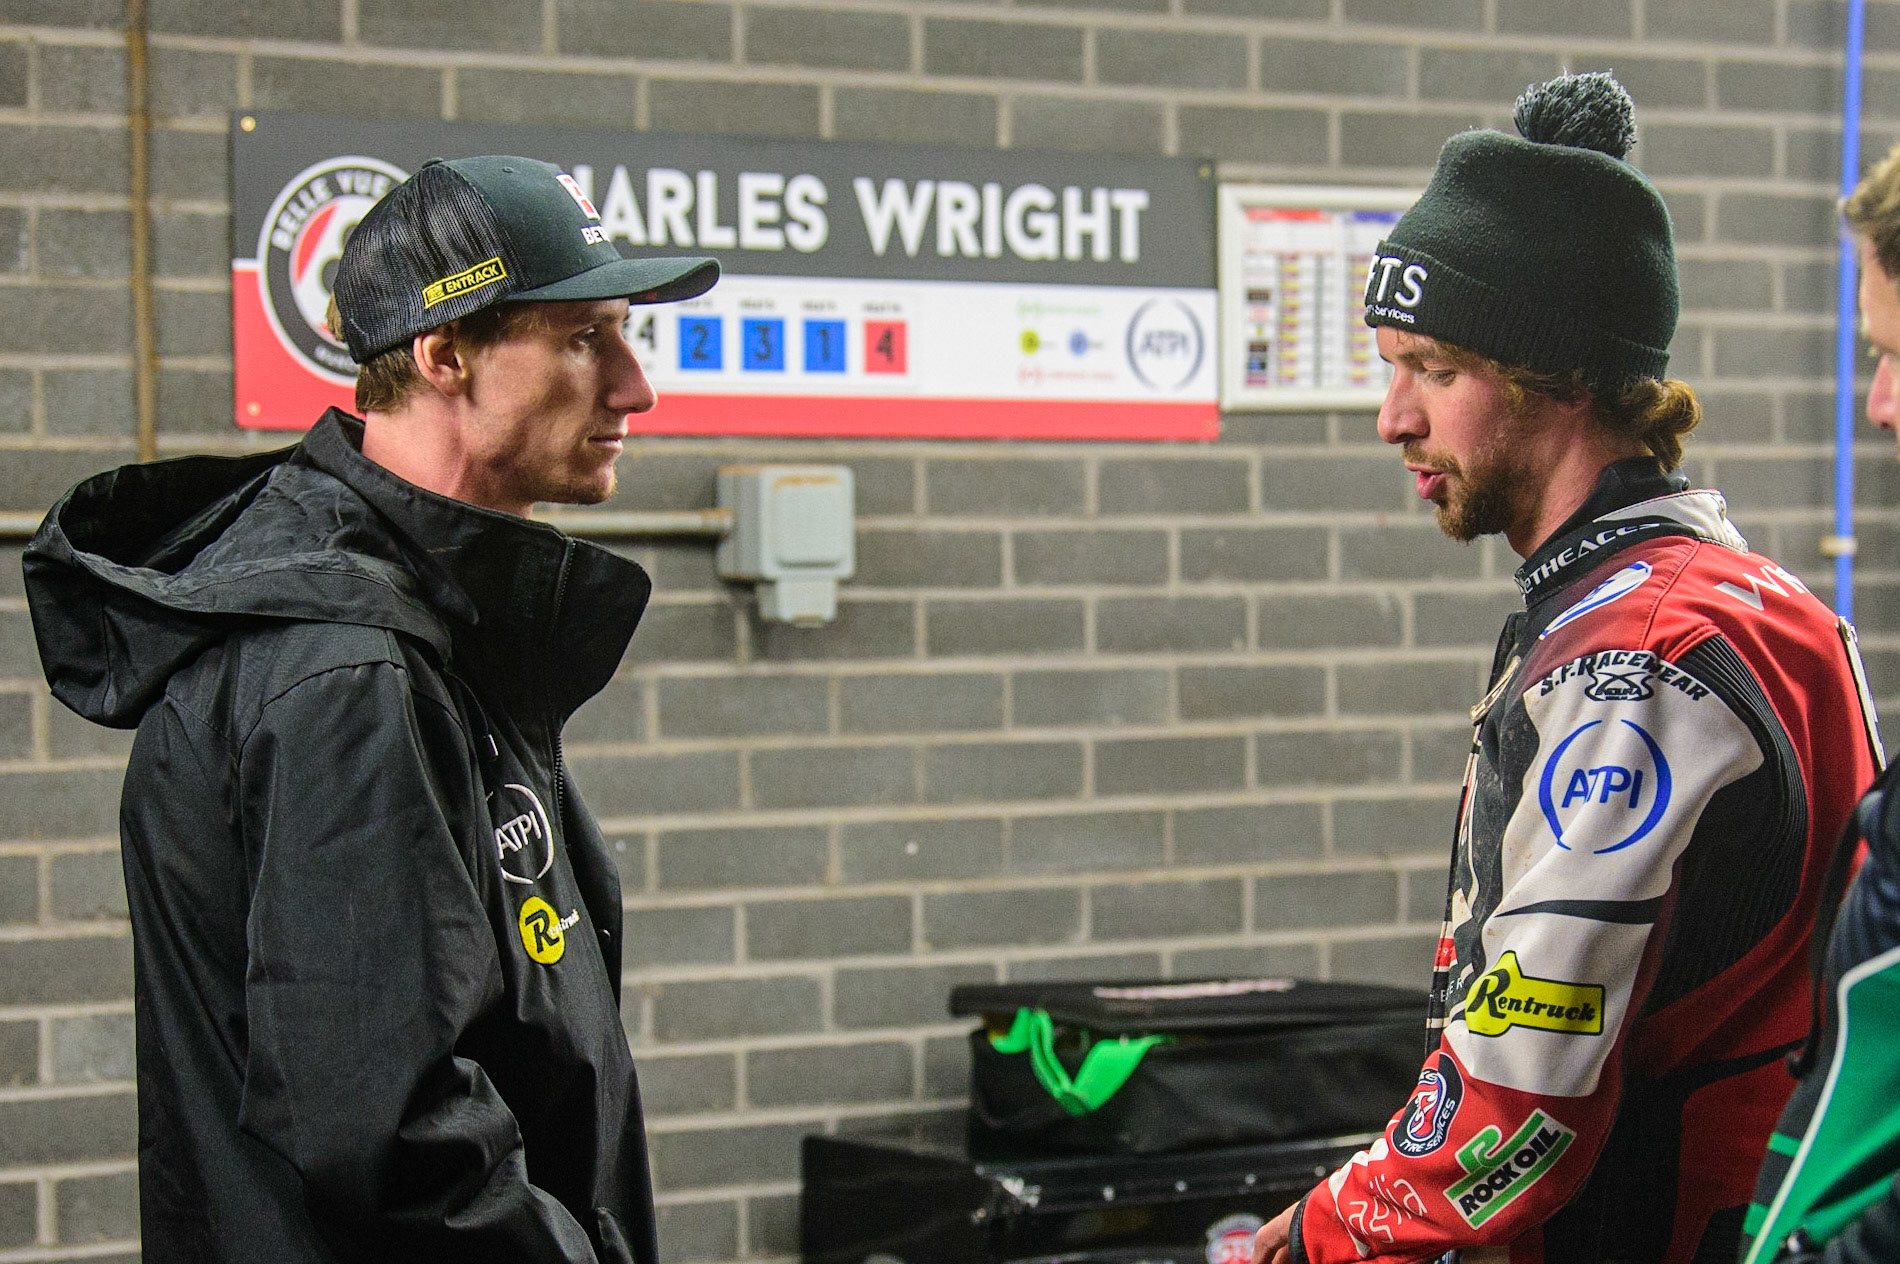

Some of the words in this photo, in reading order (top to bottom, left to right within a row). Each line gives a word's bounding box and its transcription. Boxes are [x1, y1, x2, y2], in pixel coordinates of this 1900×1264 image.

[271, 177, 333, 251] BELLE
[336, 169, 392, 199] VUE
[853, 177, 1150, 262] WRIGHT
[445, 264, 499, 293] ENTRACK
[1374, 304, 1415, 324] Services
[692, 323, 709, 360] 2
[754, 324, 772, 360] 3
[875, 328, 894, 363] 4
[1562, 766, 1643, 809] ATPI
[495, 810, 541, 860] ATPI
[1467, 968, 1596, 1022] Rentruck
[1399, 1138, 1425, 1152] TYRE
[1458, 1156, 1518, 1217] ROCK
[1516, 1127, 1561, 1176] OIL
